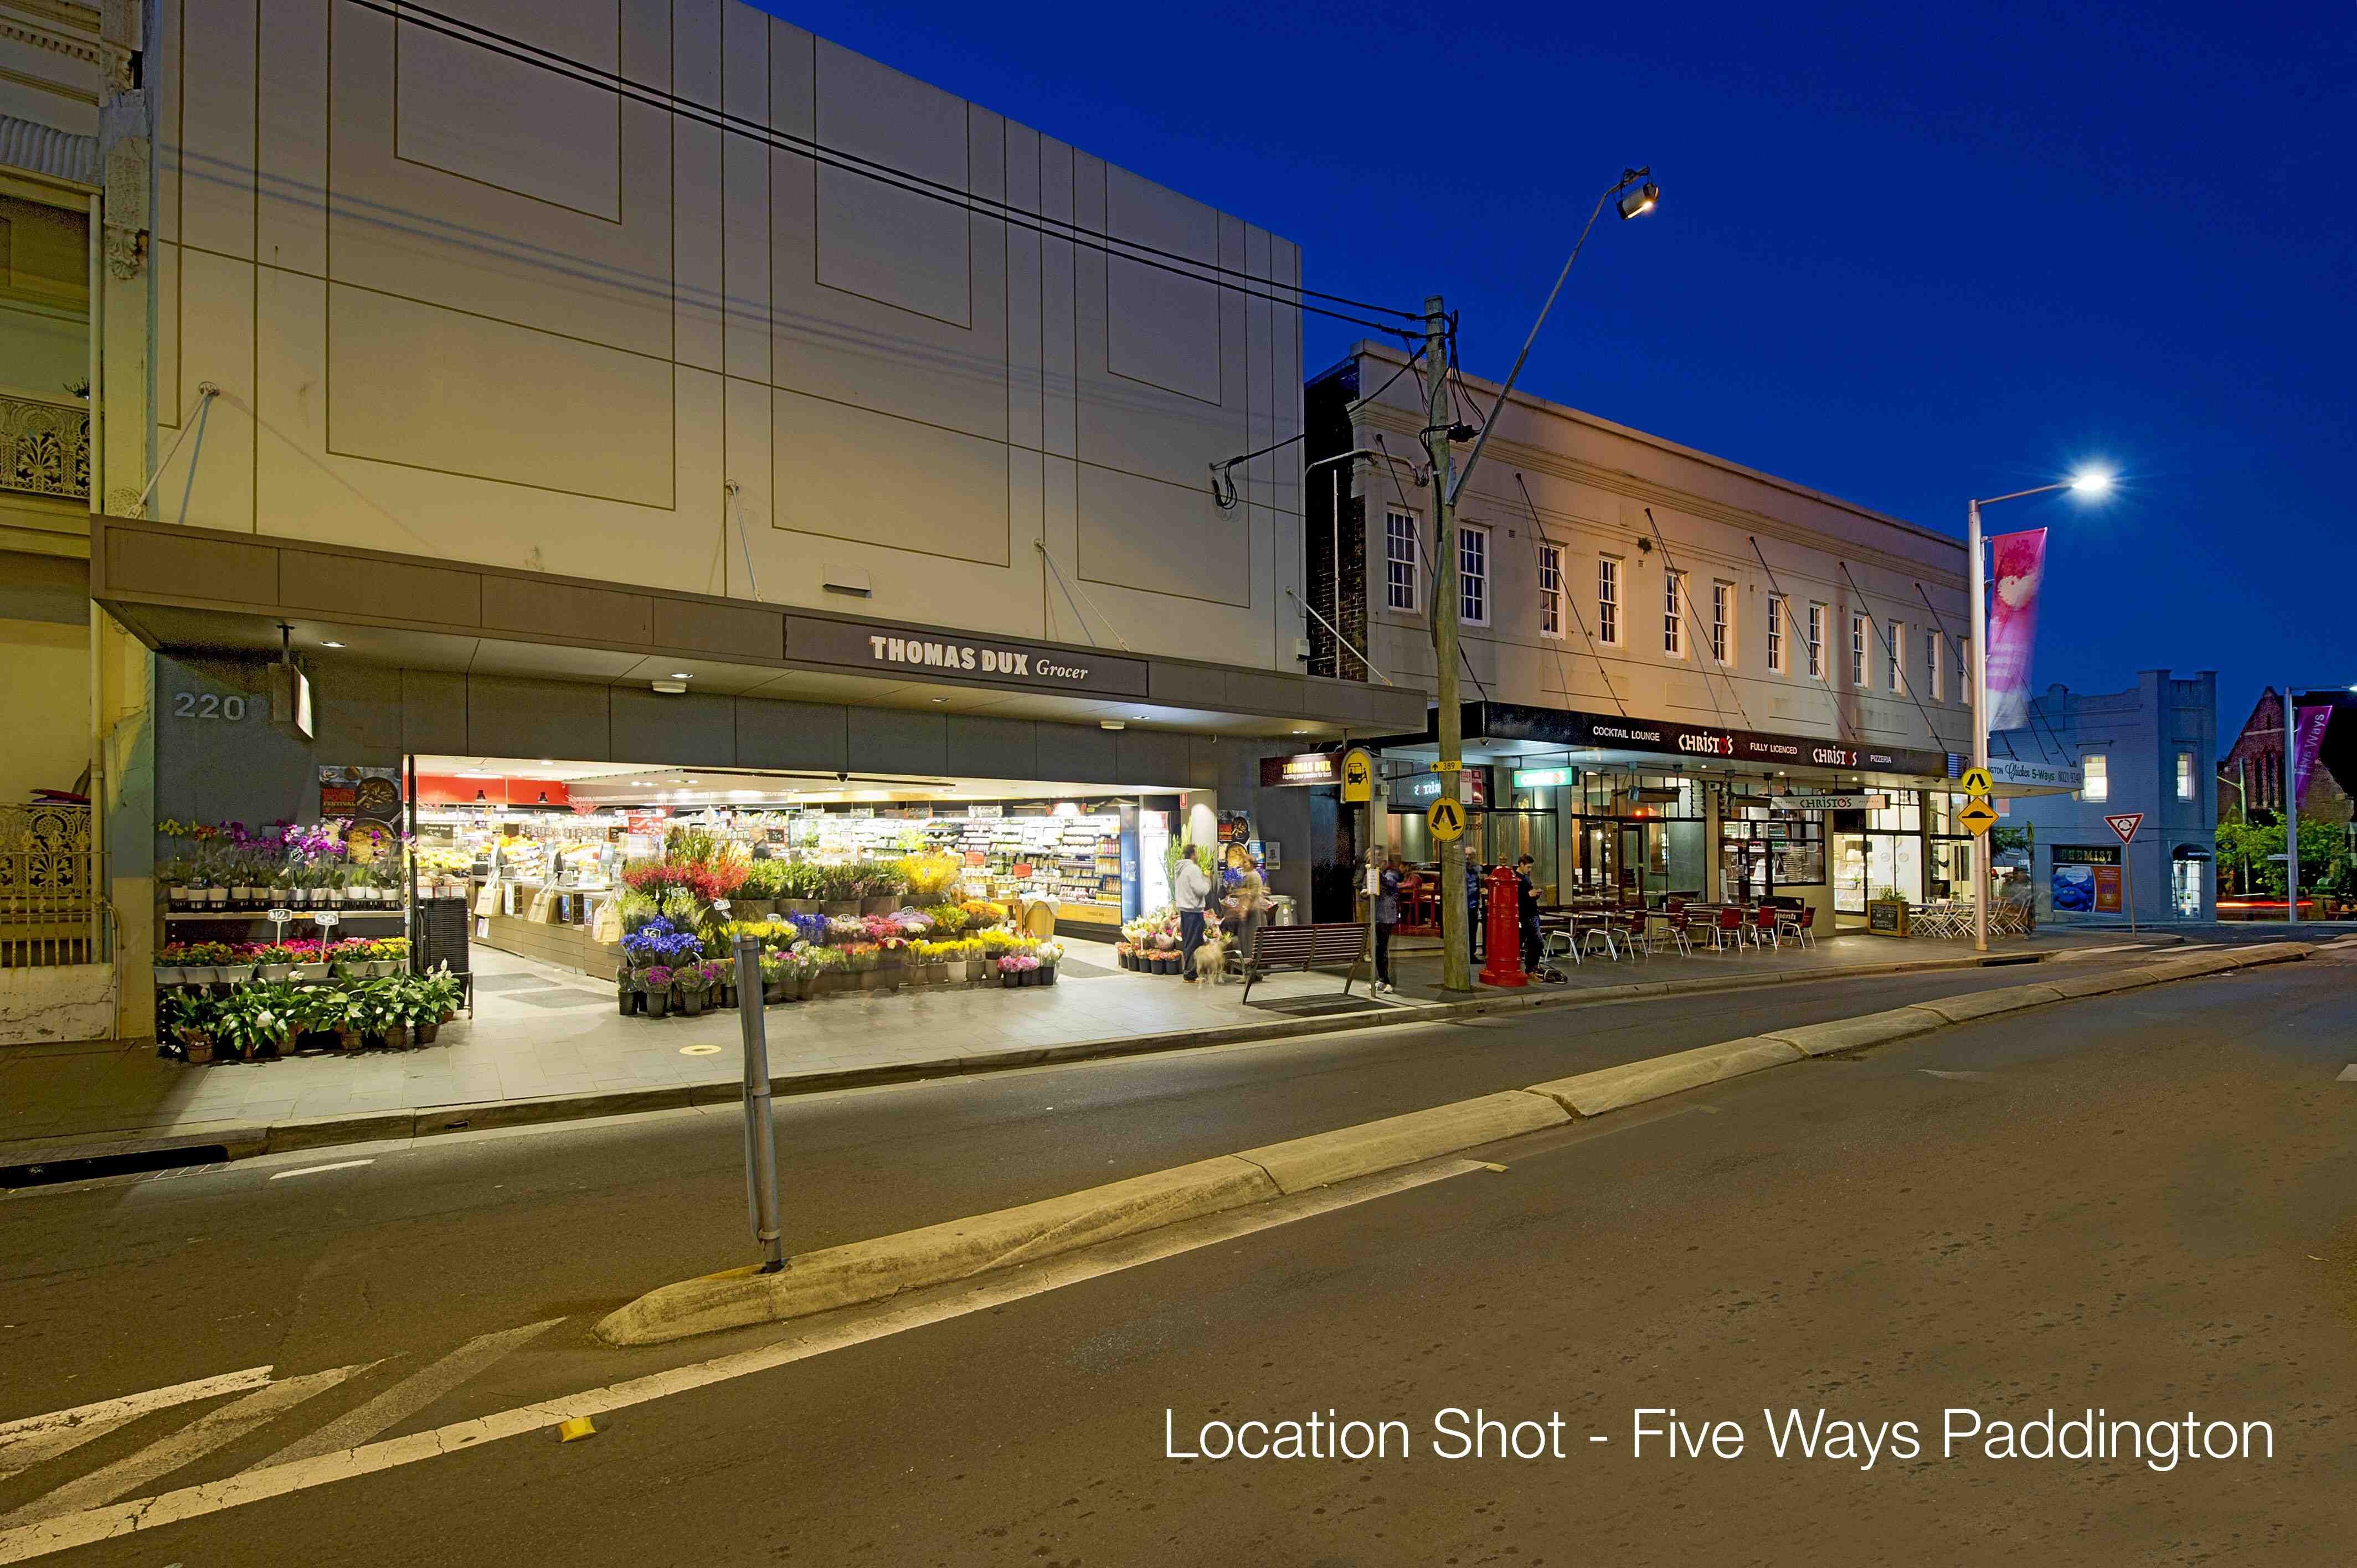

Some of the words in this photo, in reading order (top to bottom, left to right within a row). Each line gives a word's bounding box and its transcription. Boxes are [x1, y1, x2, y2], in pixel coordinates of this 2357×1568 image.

[869, 635, 975, 670] THOMAS
[981, 649, 1029, 676] DUX
[1036, 659, 1089, 680] Grocer
[173, 692, 245, 720] 220
[1593, 726, 1629, 739] COCKTAIL
[1631, 730, 1660, 741] LOUNGE
[2304, 713, 2325, 747] Ways
[1749, 742, 1768, 752] FULLY
[1770, 745, 1798, 755] LICENCED
[1315, 760, 1331, 771] DUX
[1870, 754, 1892, 764] PIZZERIA
[2005, 762, 2030, 782] Chicken
[2032, 768, 2055, 782] 5-Ways
